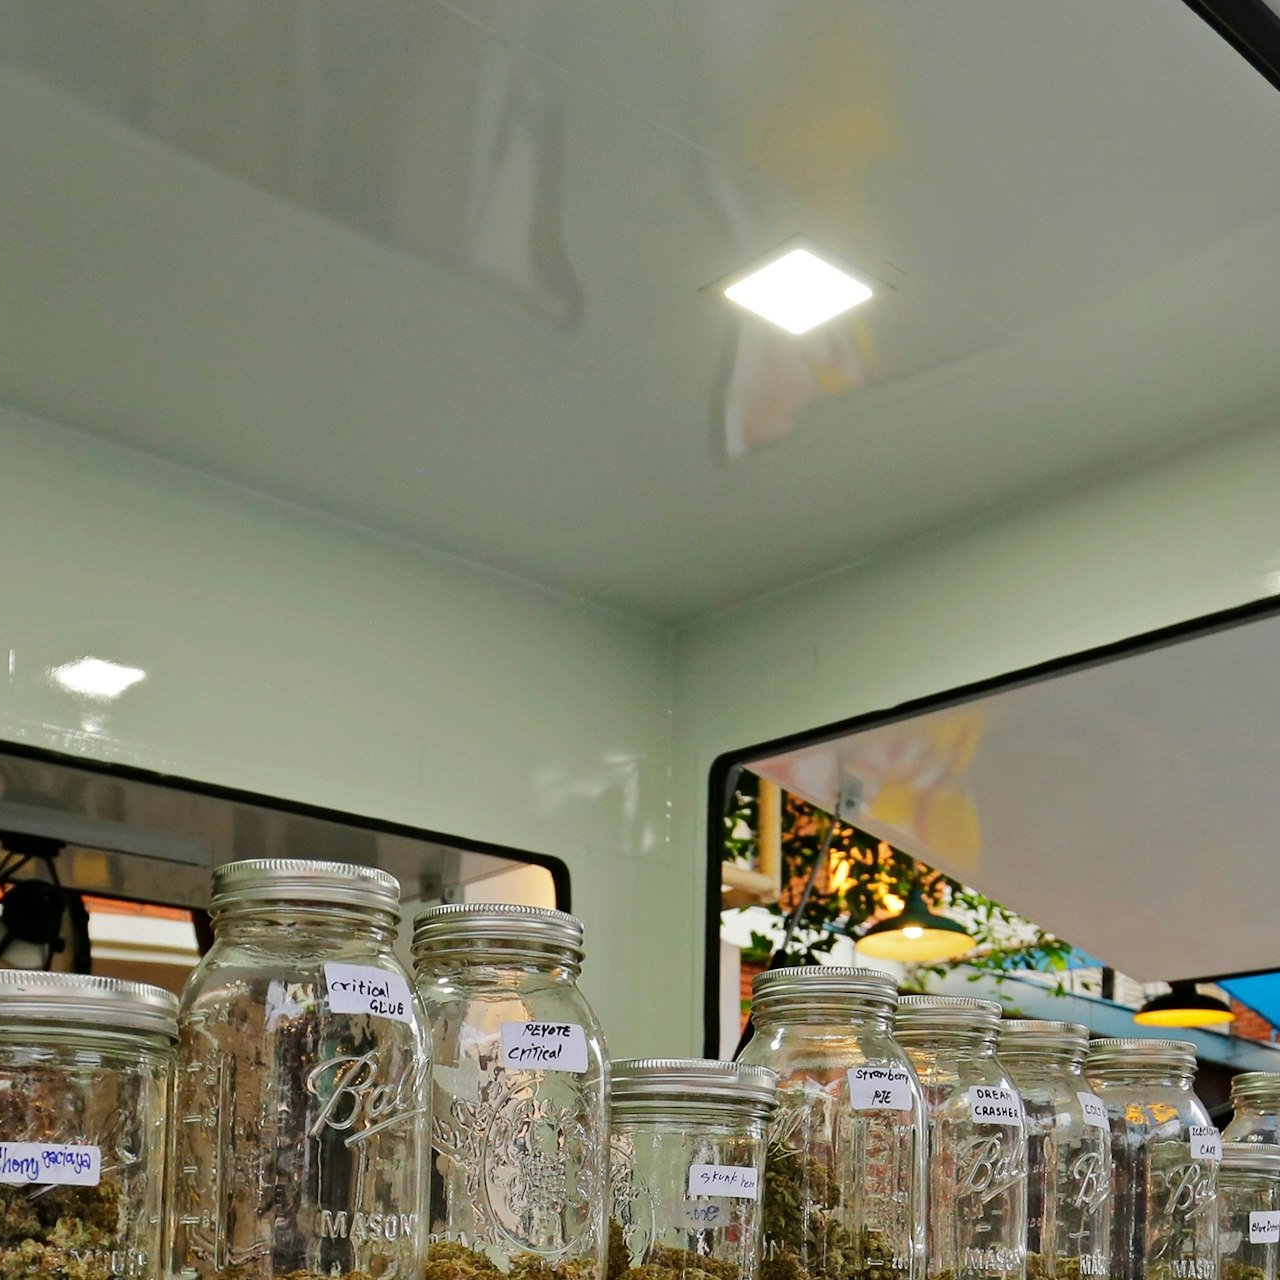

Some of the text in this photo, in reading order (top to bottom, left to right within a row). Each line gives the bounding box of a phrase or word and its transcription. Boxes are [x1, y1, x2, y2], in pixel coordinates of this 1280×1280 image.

[331, 978, 390, 999] critical
[522, 1023, 571, 1038] PEYOTE
[976, 1088, 1013, 1101] DREAM
[974, 1104, 1019, 1118] CRASHER
